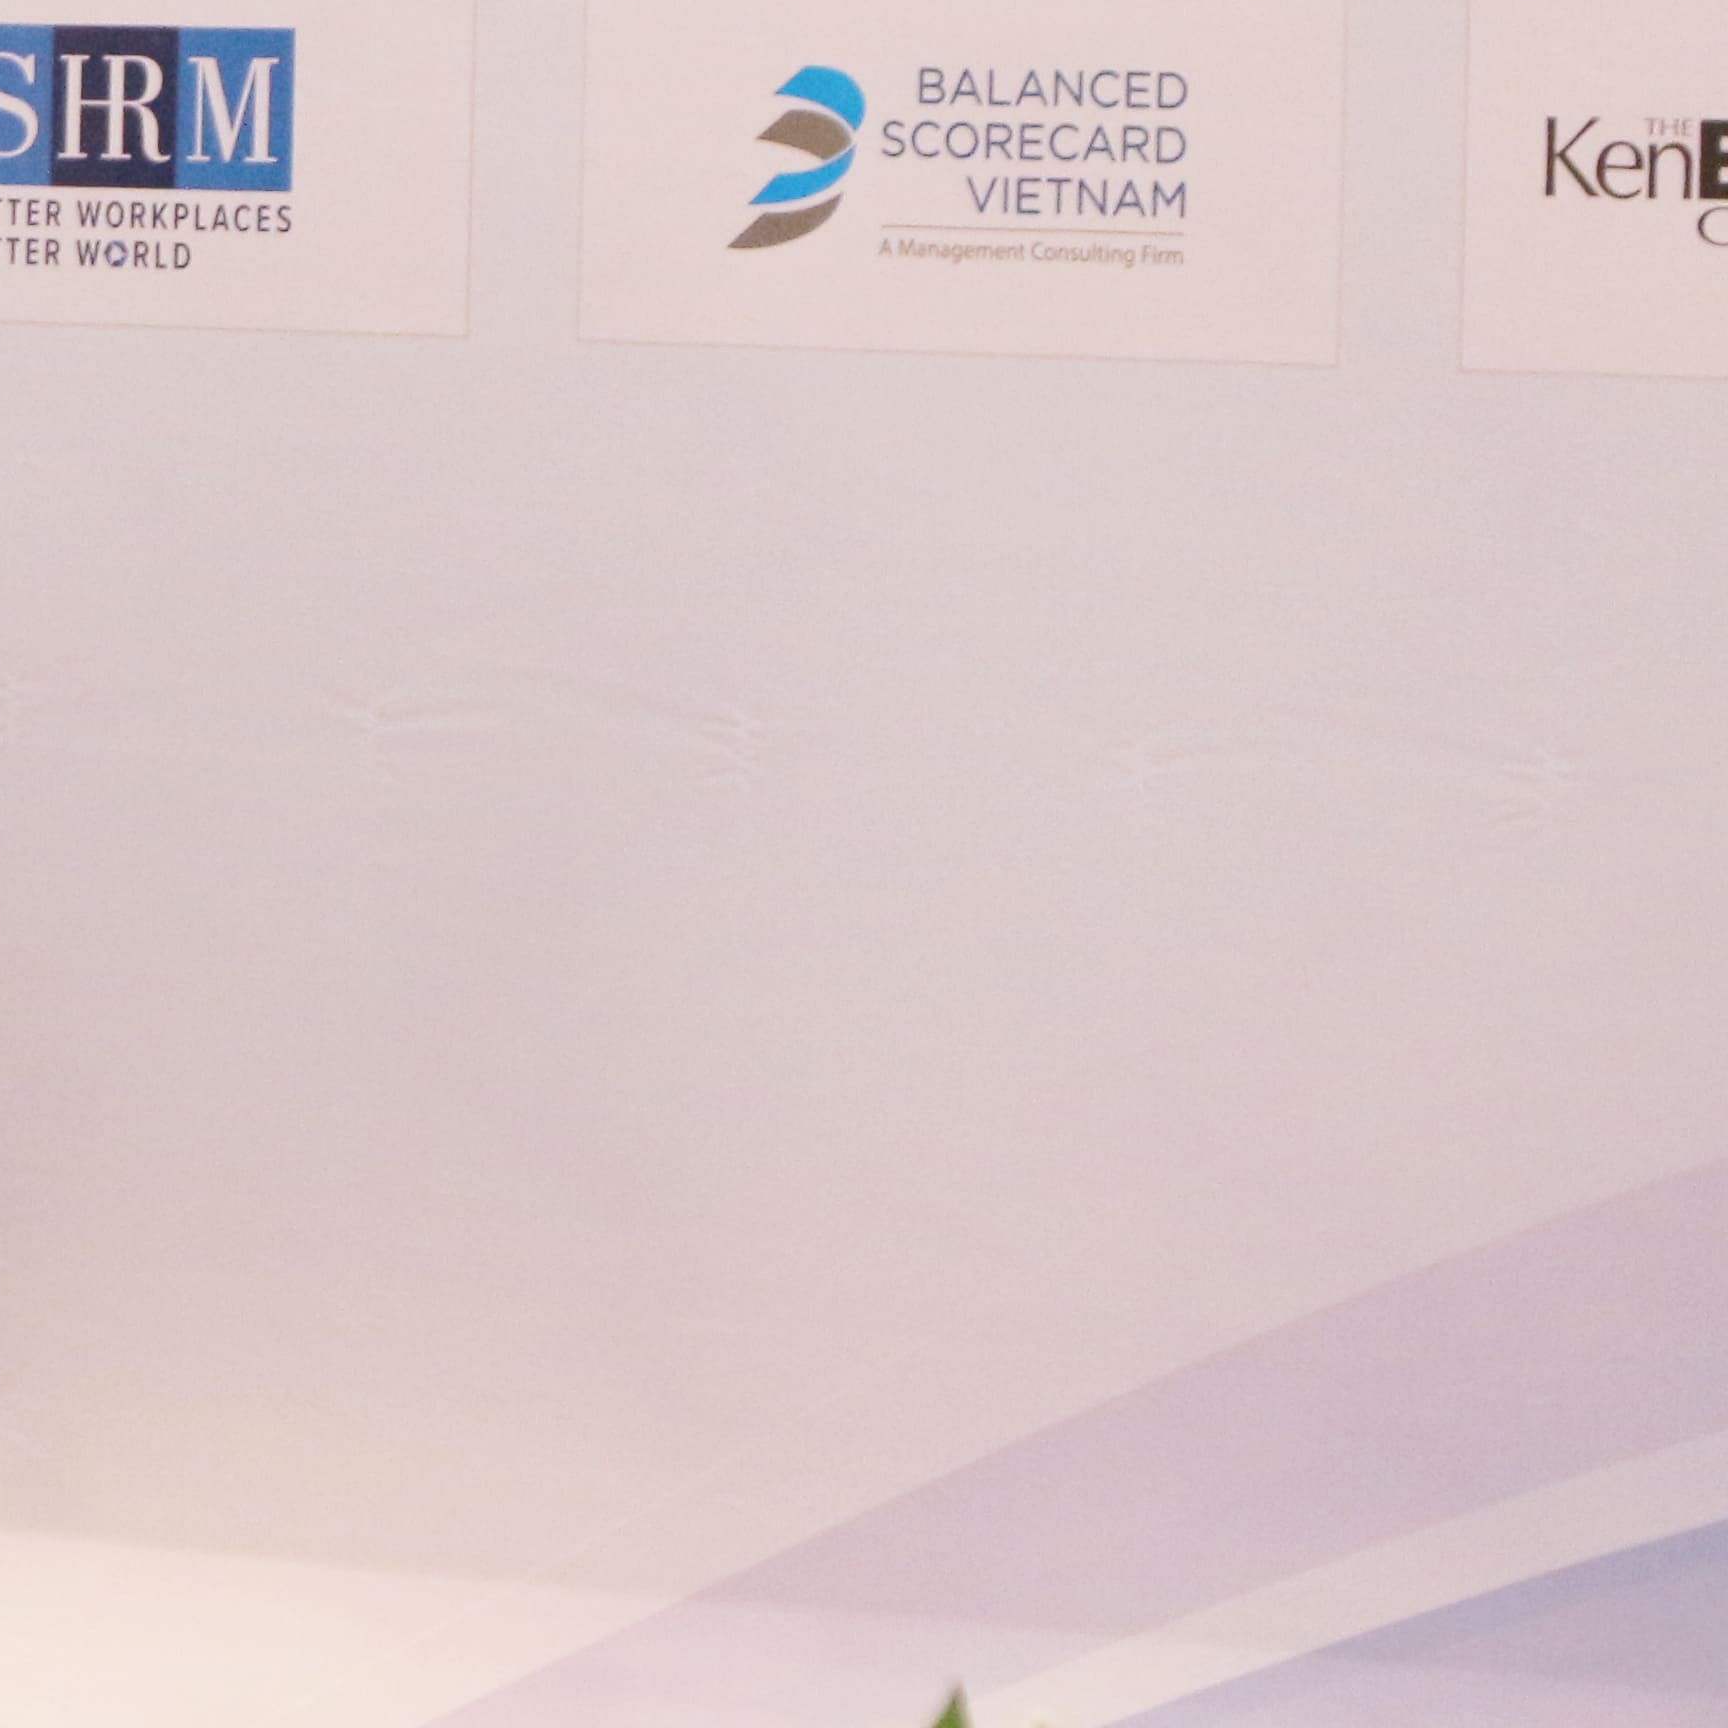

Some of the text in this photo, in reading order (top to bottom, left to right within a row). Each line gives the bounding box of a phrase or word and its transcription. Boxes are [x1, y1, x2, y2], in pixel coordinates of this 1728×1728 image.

[917, 67, 1189, 110] BALANCED
[880, 119, 1188, 165] SCORECARD
[1644, 116, 1693, 137] THE
[966, 175, 1187, 219] VIETNAM
[76, 200, 293, 234] WORKPLACES
[75, 239, 192, 270] WORLD
[878, 237, 1186, 270] A Management Consulting Firm
